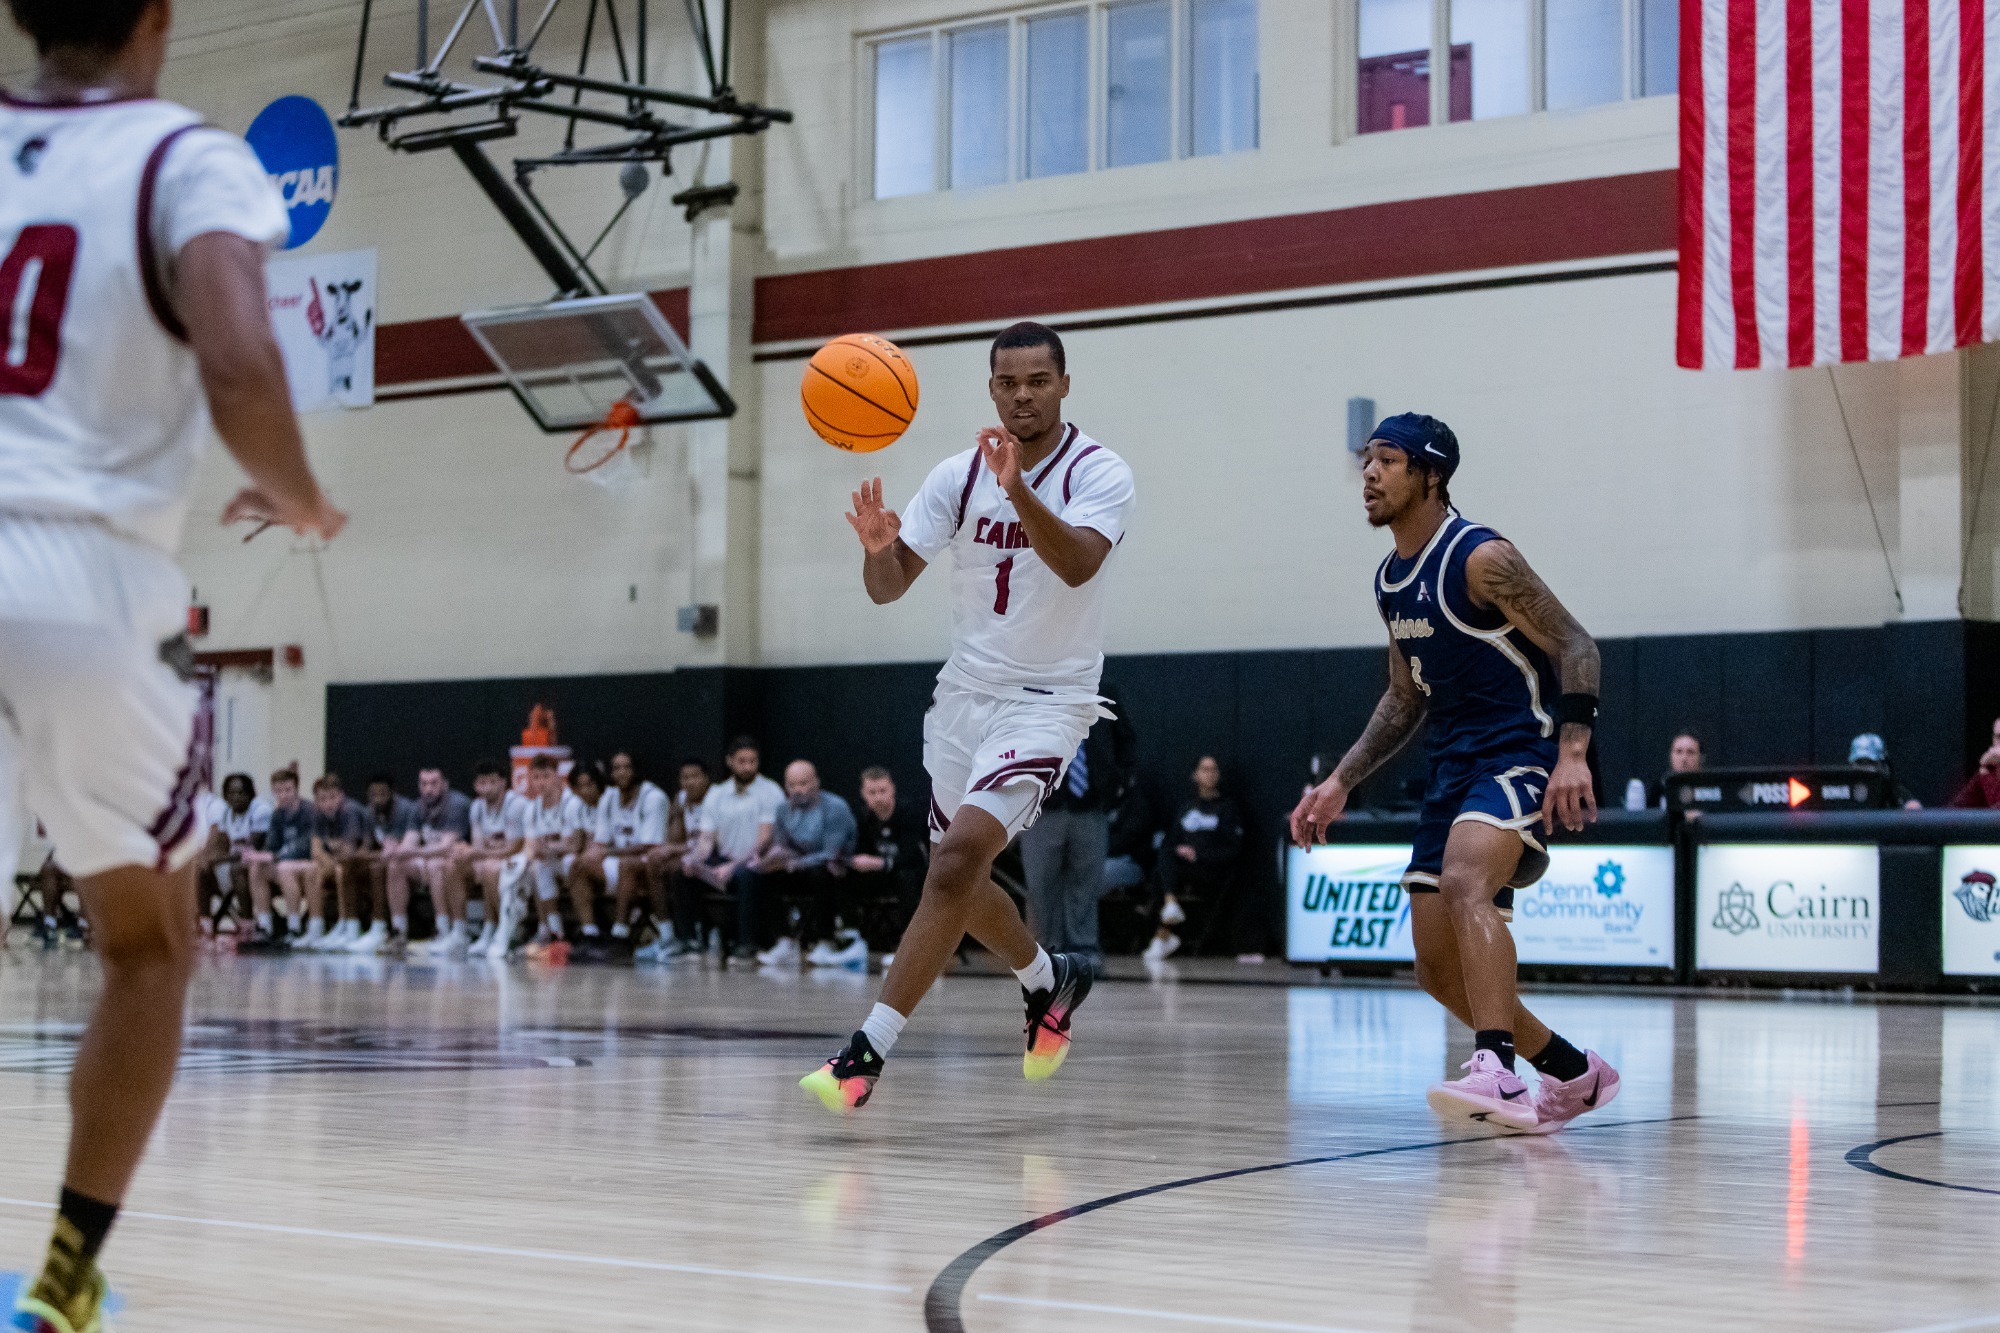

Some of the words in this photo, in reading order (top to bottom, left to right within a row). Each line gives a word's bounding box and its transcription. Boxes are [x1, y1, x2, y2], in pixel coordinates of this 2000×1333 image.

[0, 222, 79, 397] 0
[973, 516, 1033, 549] CAIR
[993, 556, 1014, 616] 1
[1752, 782, 1789, 804] POSS
[1304, 874, 1401, 912] UNITED
[1539, 881, 1592, 899] Penn
[1767, 880, 1870, 919] Cairn
[1522, 898, 1644, 925] Community
[1331, 917, 1394, 948] EAST
[1767, 922, 1872, 938] UNIVERSITY
